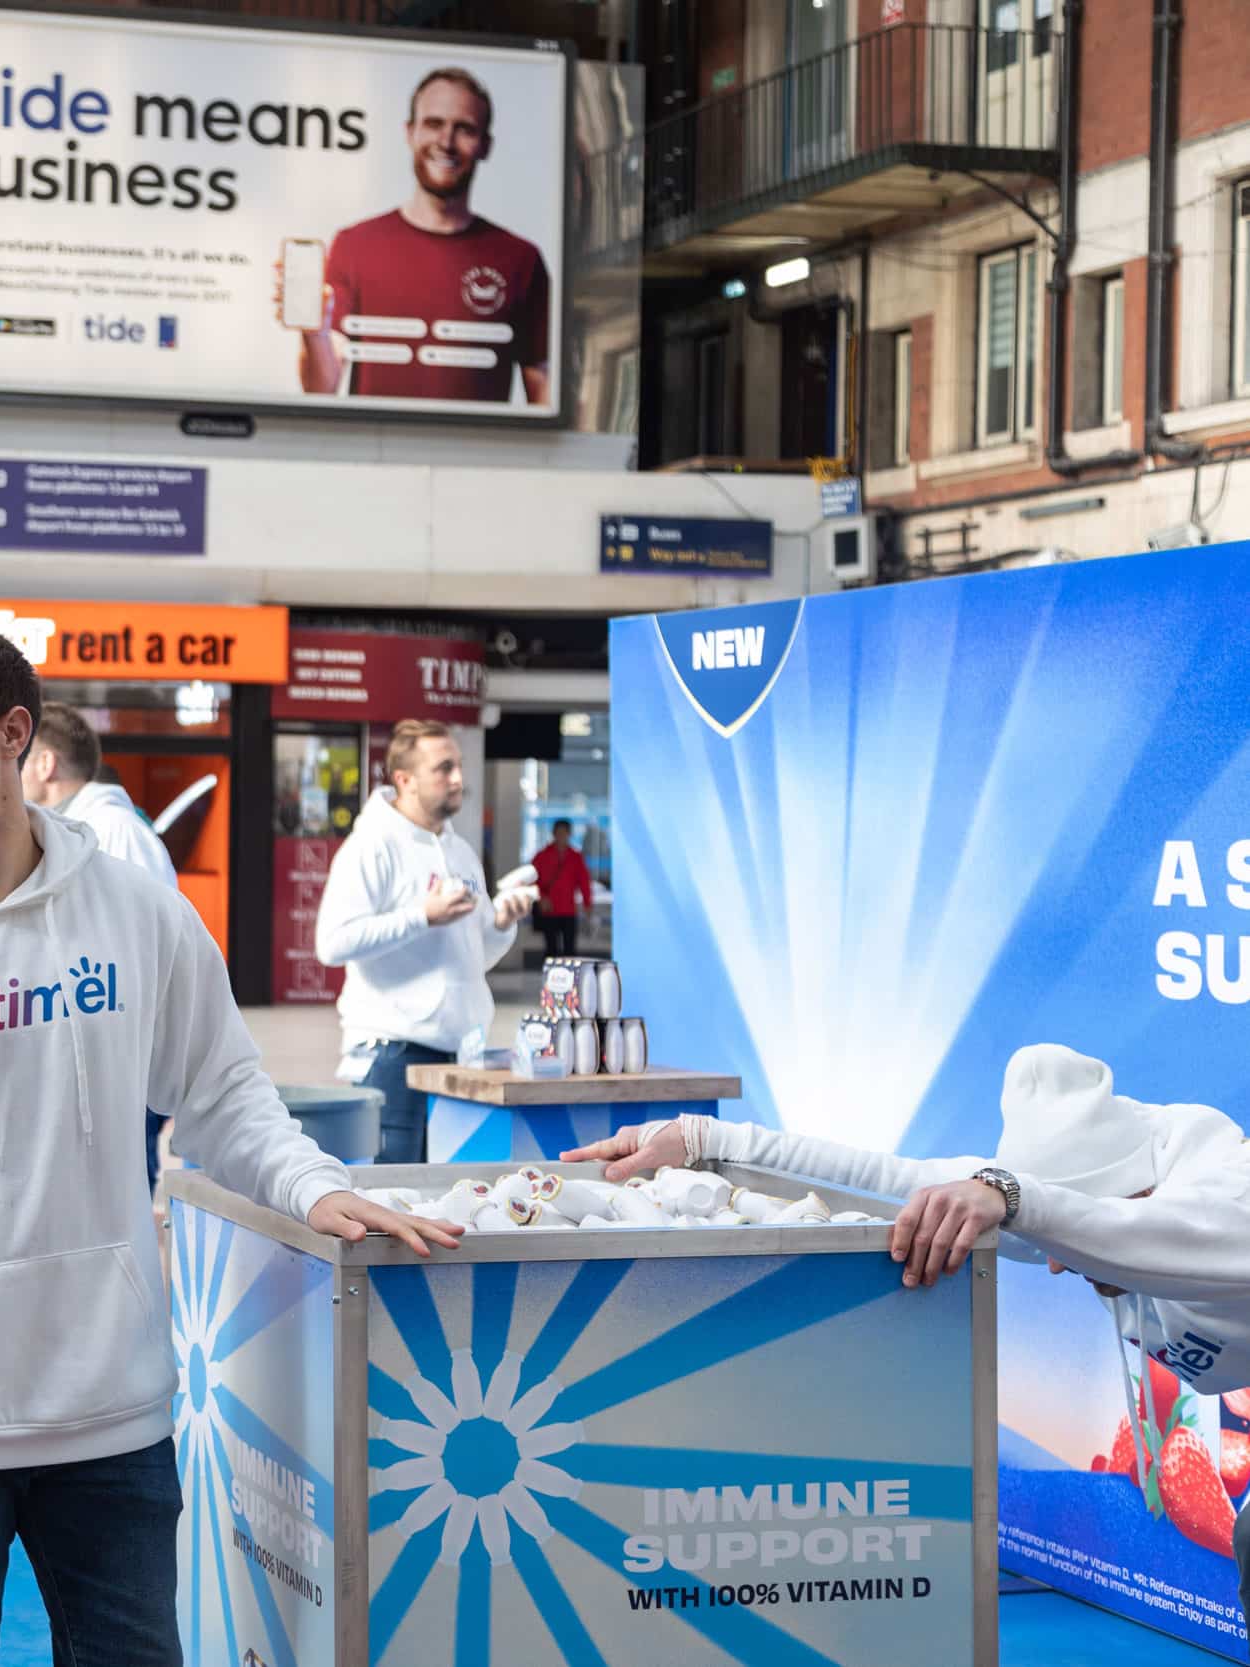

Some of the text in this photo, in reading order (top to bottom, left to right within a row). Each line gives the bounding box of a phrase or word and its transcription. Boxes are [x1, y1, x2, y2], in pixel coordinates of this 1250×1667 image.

[134, 92, 367, 152] means
[84, 315, 146, 343] tide
[60, 627, 135, 664] rent
[145, 631, 166, 664] a
[178, 631, 235, 665] car
[692, 625, 766, 671] NEW
[1152, 840, 1208, 908] A
[1155, 930, 1250, 1005] SU
[237, 1439, 316, 1520] IMMUNE
[643, 1479, 910, 1525] IMMUNE
[231, 1477, 322, 1568] SUPPORT
[623, 1525, 932, 1573] SUPPORT
[233, 1527, 323, 1608] WITH 100% VITAMIN D
[628, 1576, 931, 1610] WITH 100% VITAMIN D
[1007, 1539, 1020, 1553] the
[1021, 1545, 1048, 1564] normal
[1049, 1554, 1083, 1577] function
[1084, 1569, 1093, 1581] of
[1094, 1573, 1108, 1588] the
[1110, 1577, 1143, 1601] immune
[1178, 1602, 1204, 1625] Enjoy
[1204, 1615, 1217, 1628] as
[1217, 1620, 1238, 1637] part
[1009, 1526, 1046, 1550] reference
[1090, 1556, 1121, 1578] Vitamin
[1150, 1577, 1195, 1604] Reference
[1225, 1607, 1236, 1619] of
